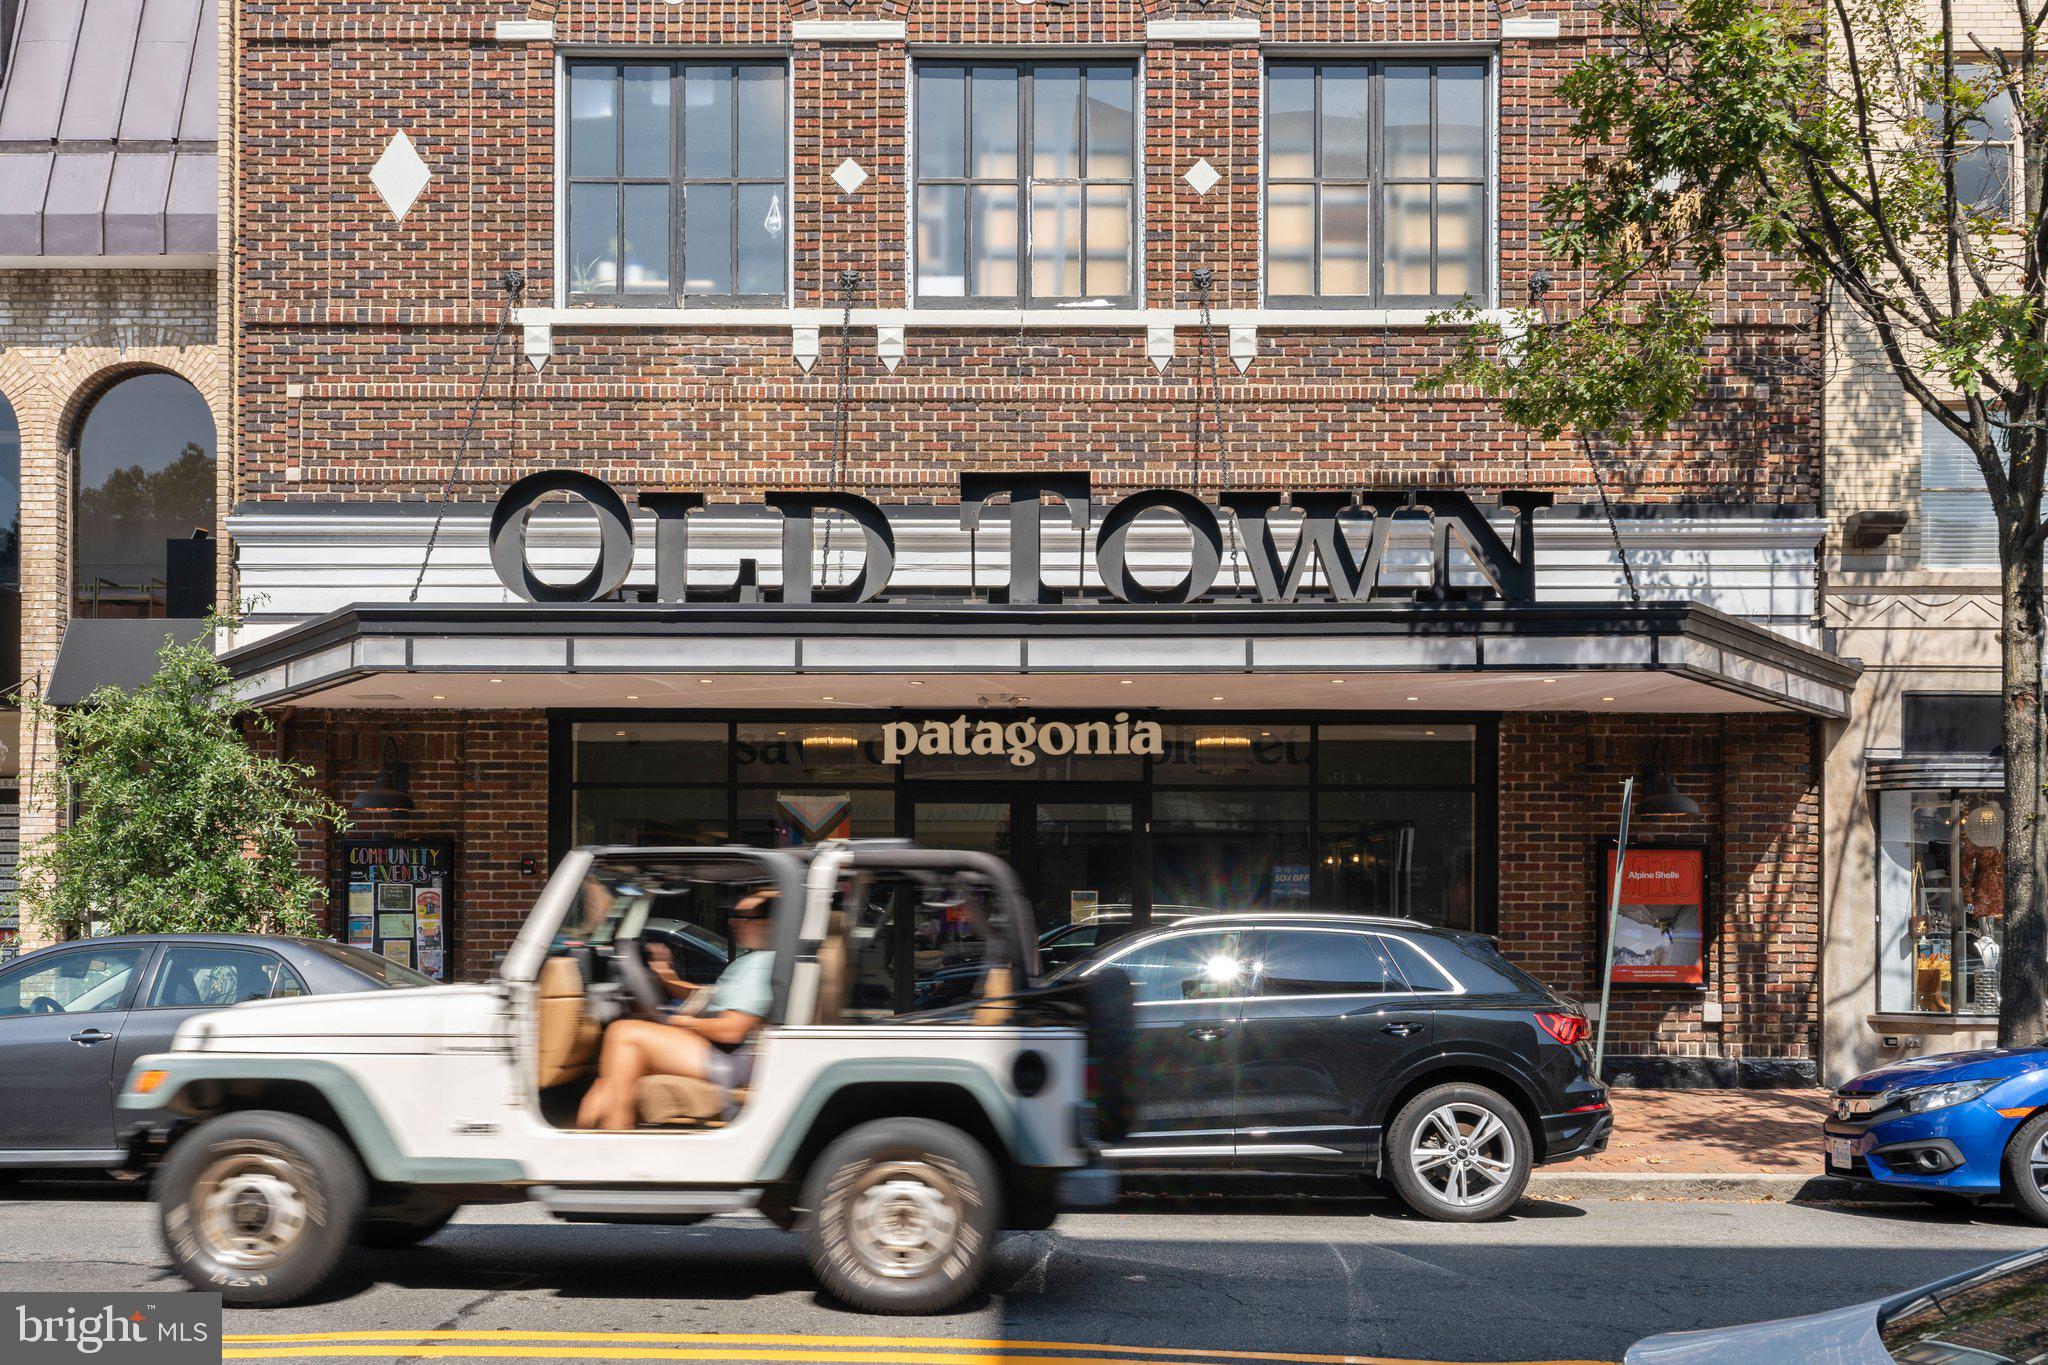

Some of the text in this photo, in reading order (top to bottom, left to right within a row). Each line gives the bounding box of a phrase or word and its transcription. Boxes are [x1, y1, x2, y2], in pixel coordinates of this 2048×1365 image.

[489, 468, 1552, 604] OLD TOWN
[882, 711, 1164, 767] patagonia
[350, 847, 440, 866] COMMUNITY
[368, 864, 429, 883] EVENTS
[1293, 874, 1310, 883] OFF
[1628, 871, 1680, 880] Alpine Shells
